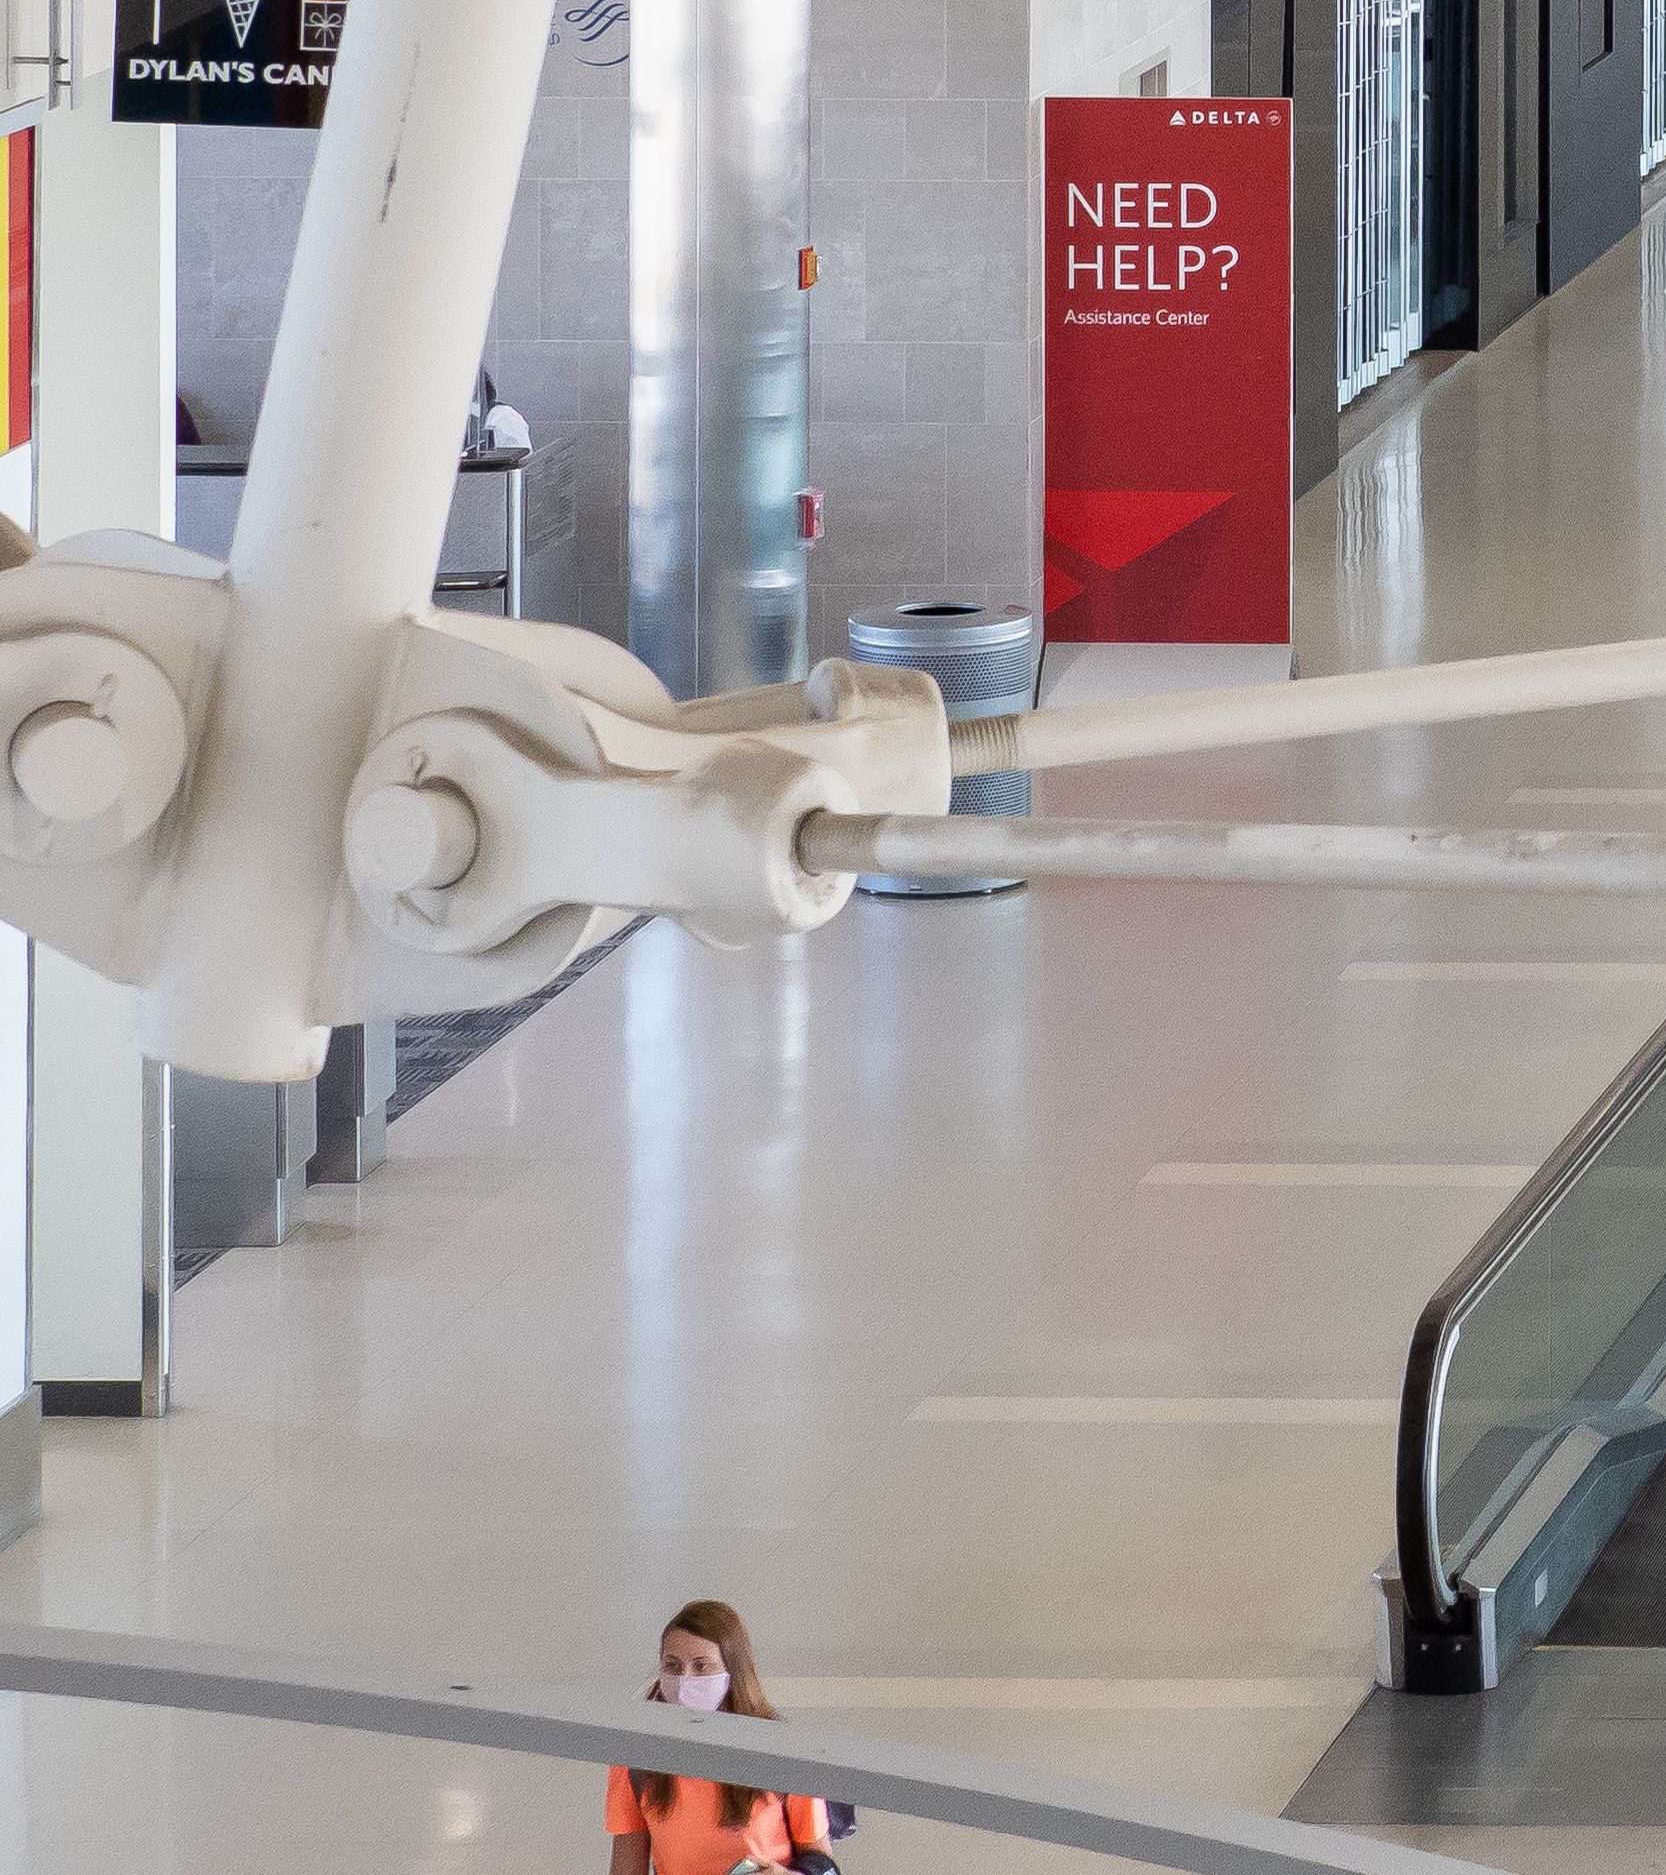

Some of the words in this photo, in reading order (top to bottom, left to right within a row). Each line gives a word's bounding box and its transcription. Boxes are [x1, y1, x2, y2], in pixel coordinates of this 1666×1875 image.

[128, 58, 255, 84] DYLAN'S
[262, 62, 337, 86] CAN
[1192, 111, 1261, 125] DELTA
[1067, 182, 1218, 228] NEED
[1067, 244, 1240, 291] HELP?
[1064, 309, 1151, 325] Assistance
[1155, 309, 1210, 325] Center
